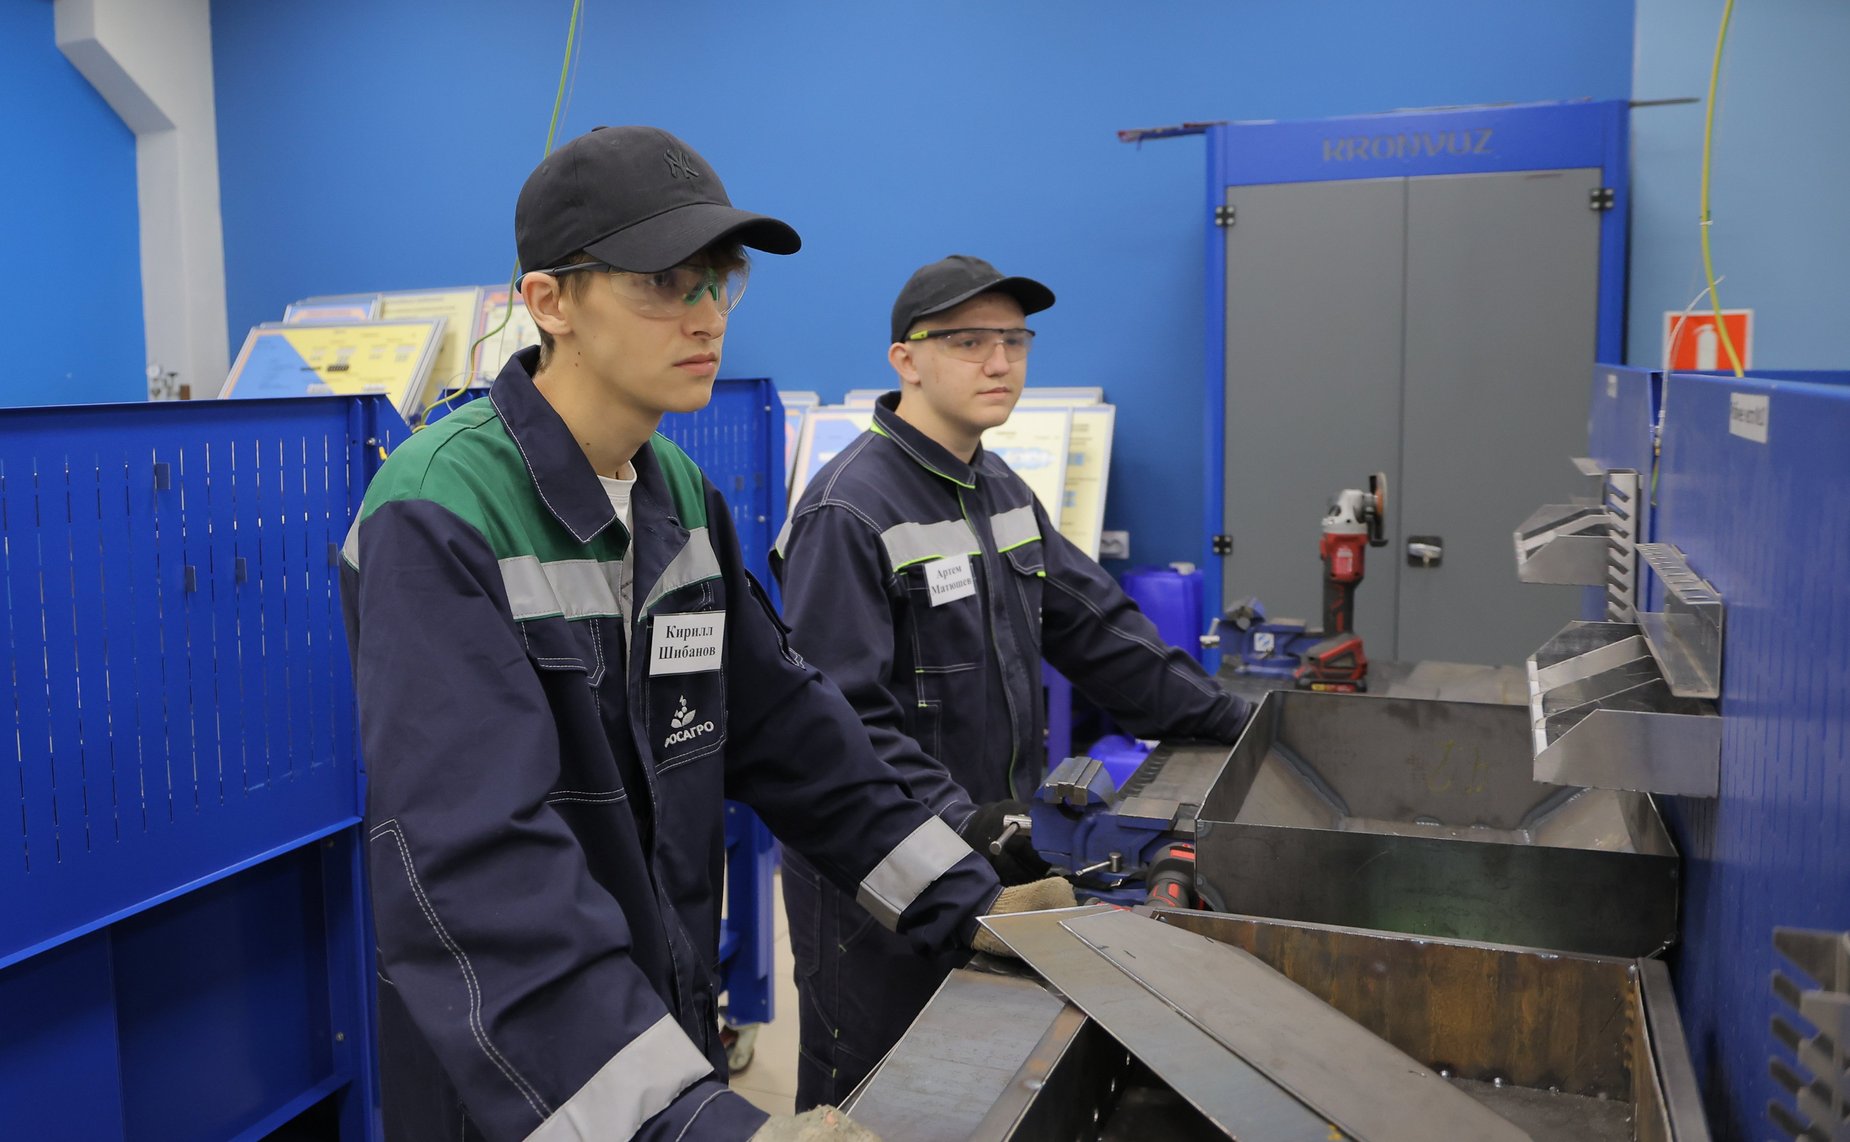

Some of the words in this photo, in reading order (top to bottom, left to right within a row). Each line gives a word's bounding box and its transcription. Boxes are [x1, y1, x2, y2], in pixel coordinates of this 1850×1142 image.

[1322, 127, 1494, 161] KRONVUZ
[665, 625, 713, 642] Кирилл
[658, 645, 716, 660] Шибанов
